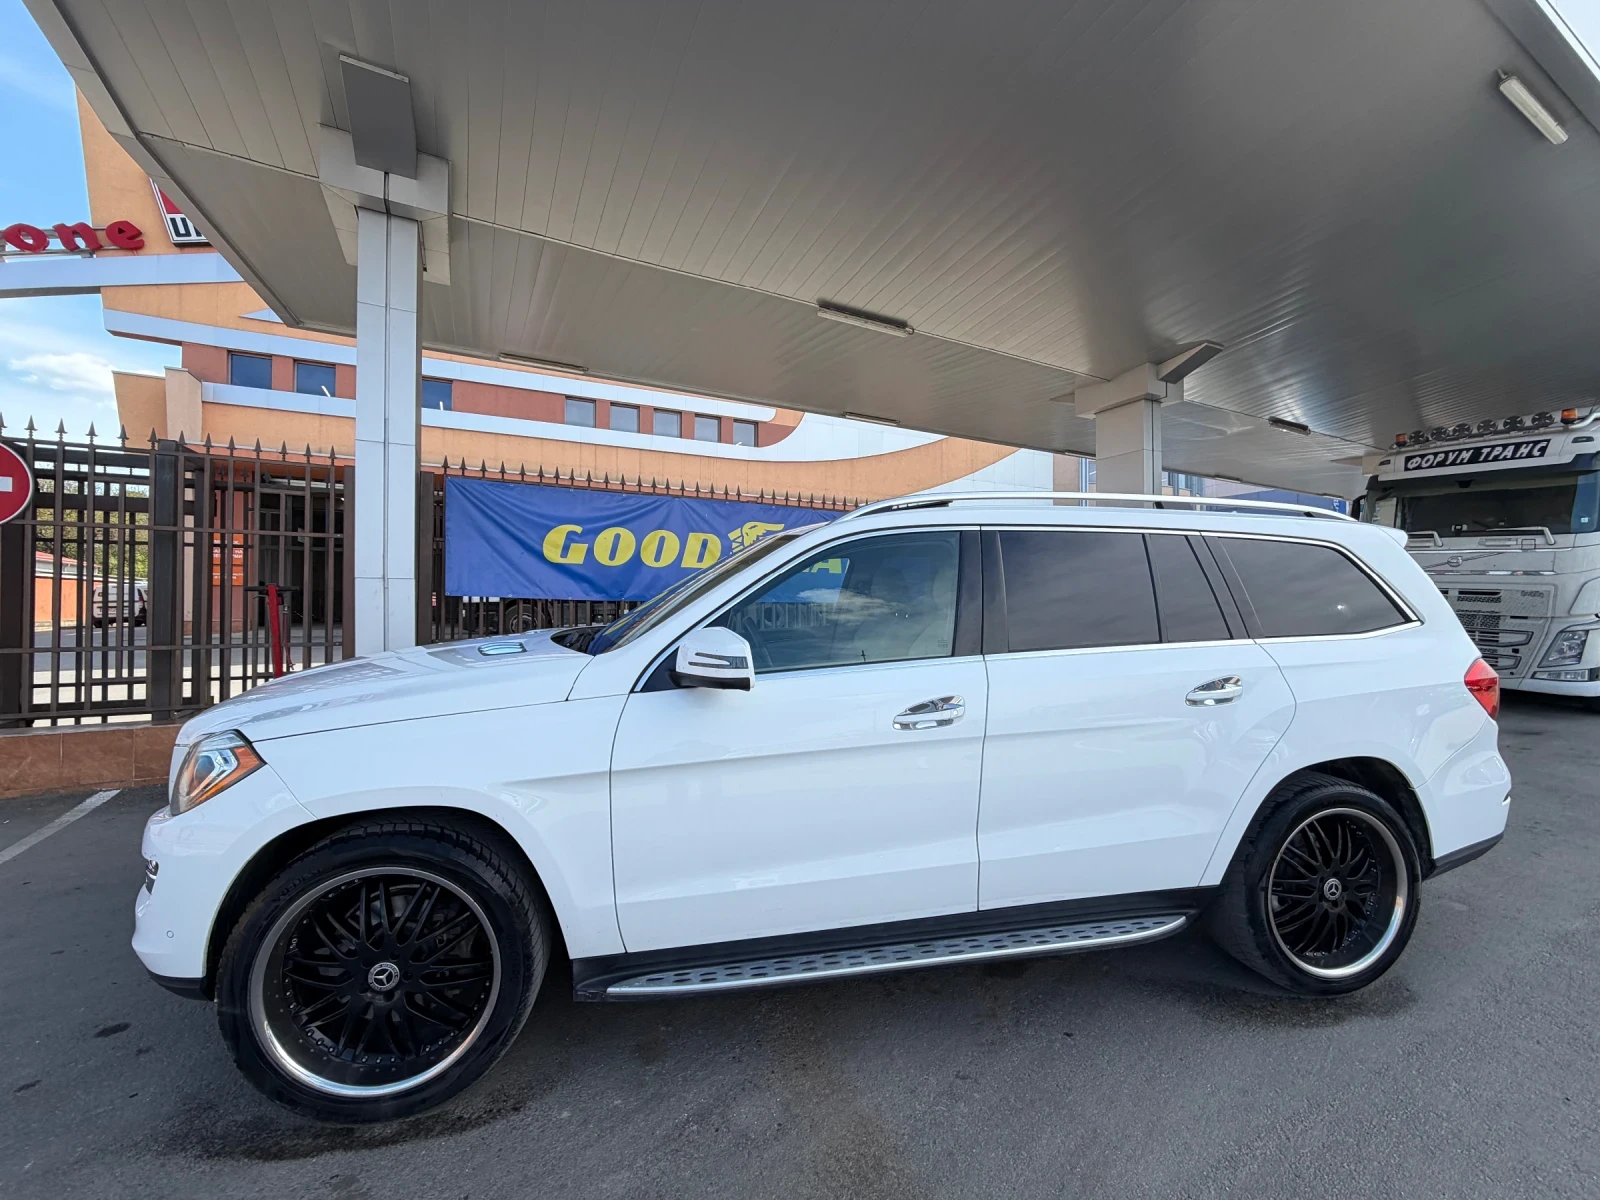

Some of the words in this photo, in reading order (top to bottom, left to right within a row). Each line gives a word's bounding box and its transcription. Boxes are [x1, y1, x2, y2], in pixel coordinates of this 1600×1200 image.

[3, 220, 145, 253] one
[169, 217, 202, 237] U
[1407, 449, 1474, 470] ФОРУМ
[1478, 441, 1548, 462] ТРАНС
[542, 524, 722, 569] GOOD
